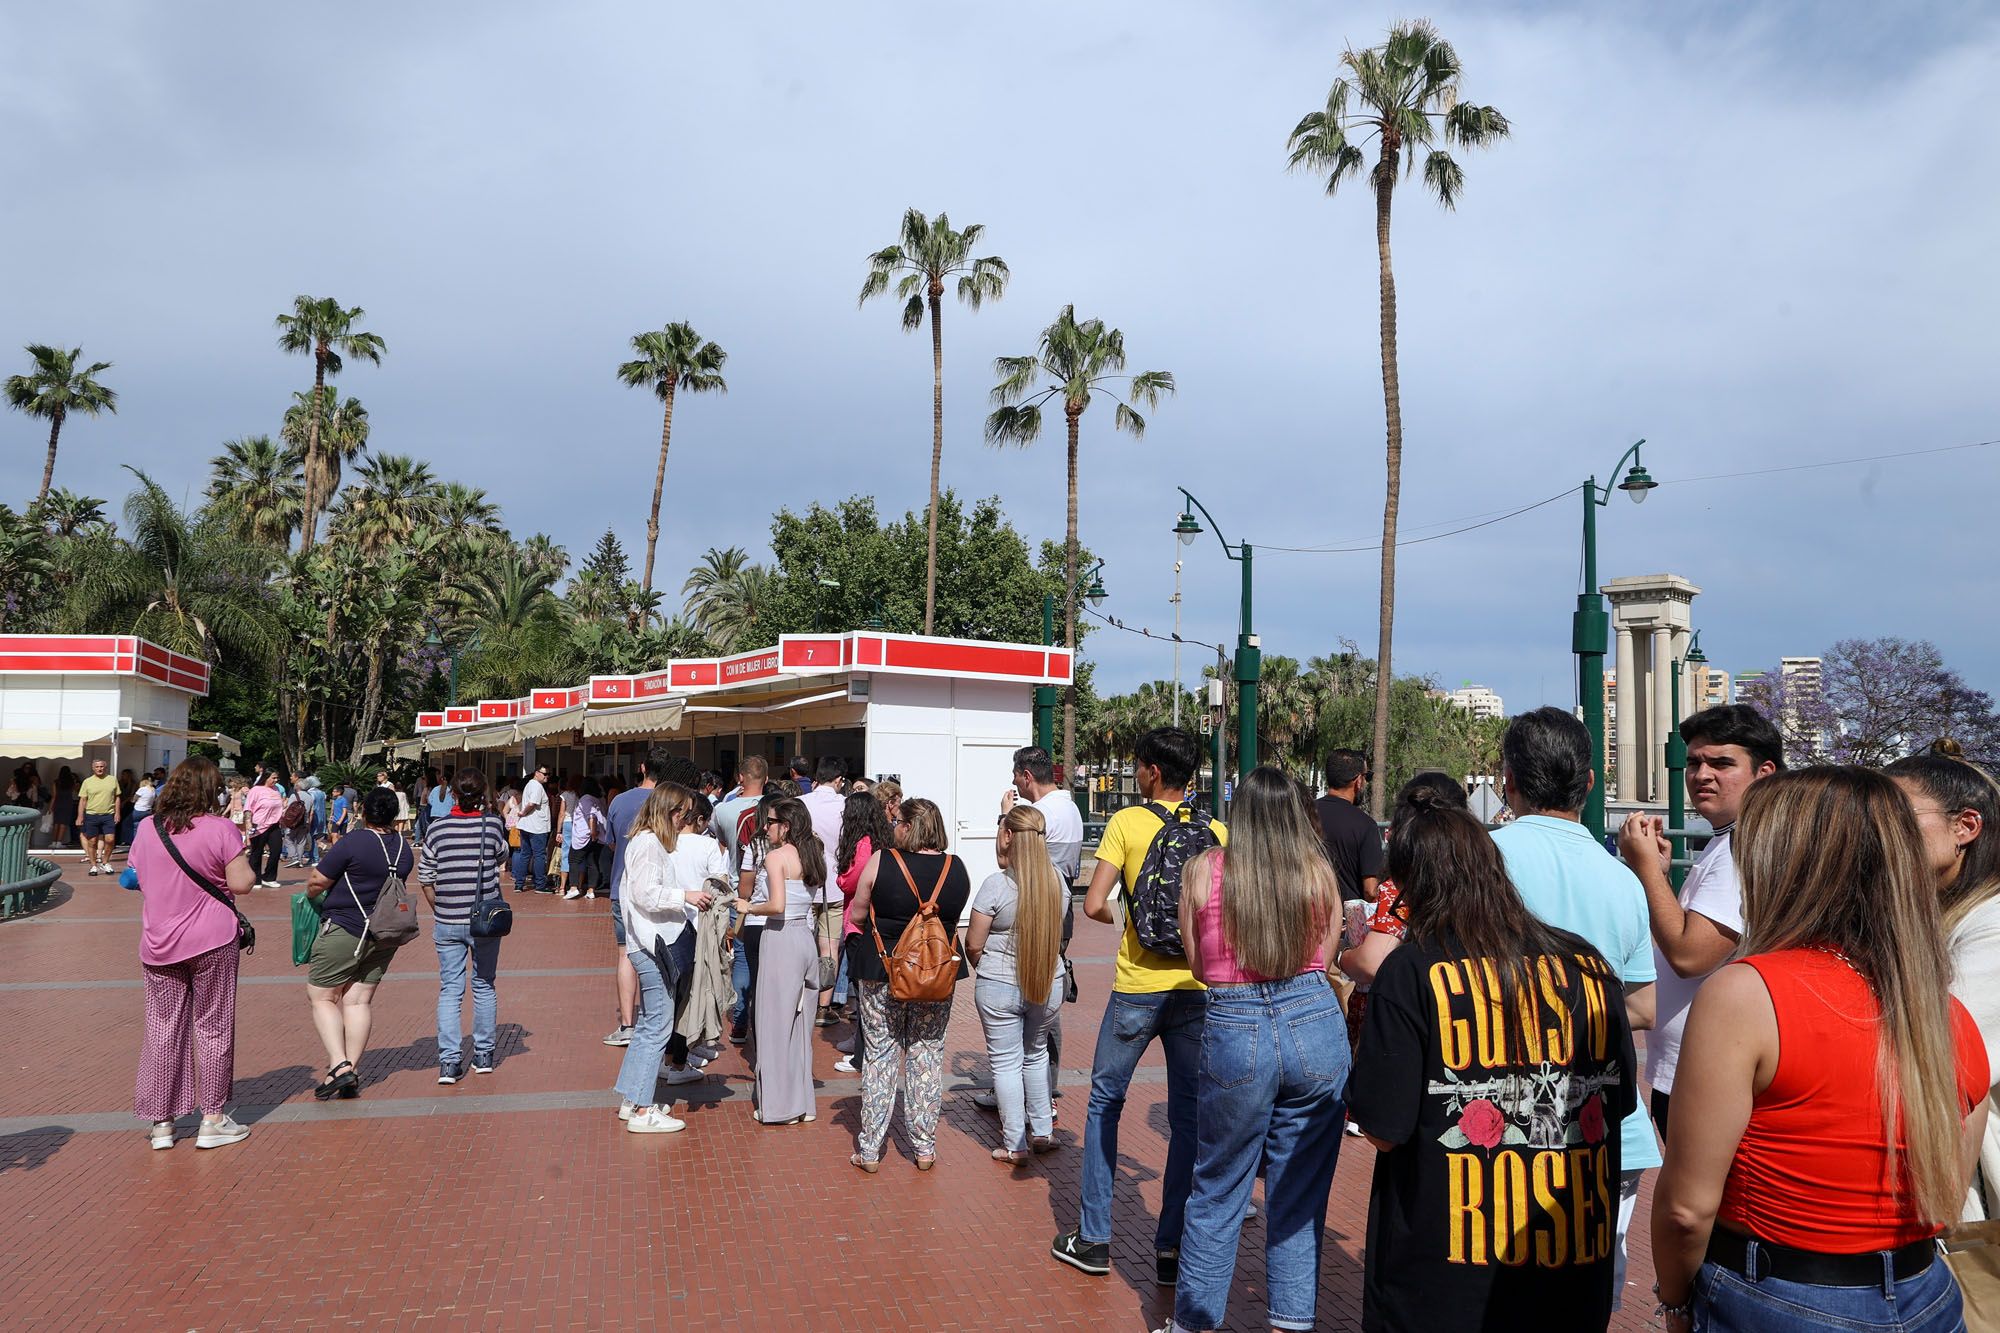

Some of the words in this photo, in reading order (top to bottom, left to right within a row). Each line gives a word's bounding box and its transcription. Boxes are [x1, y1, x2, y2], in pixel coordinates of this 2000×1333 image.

[807, 649, 814, 661] 7
[725, 664, 735, 677] CON
[739, 662, 746, 674] DE
[747, 660, 761, 673] MUJER
[690, 670, 697, 680] 6
[605, 685, 617, 693] 4-5
[544, 697, 555, 705] 4-5
[1429, 954, 1574, 1071] GUNS
[1445, 1144, 1611, 1268] ROSES
